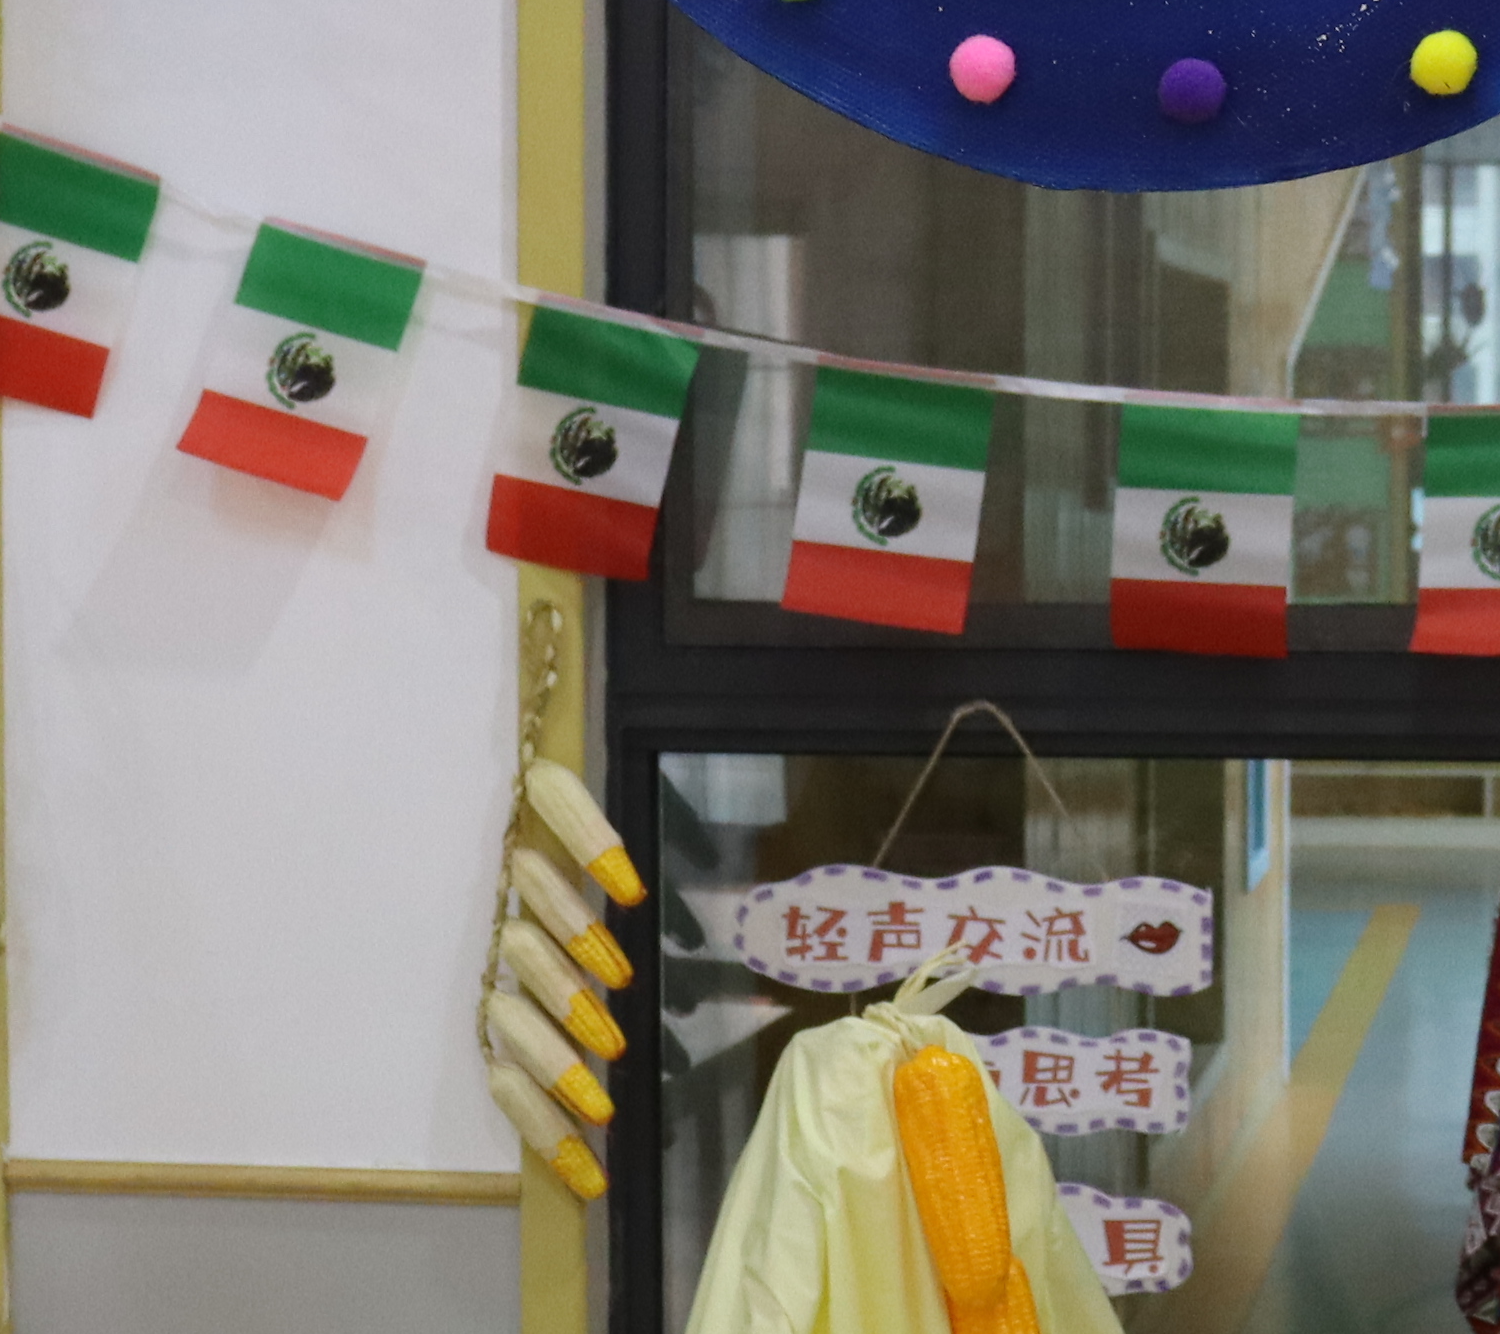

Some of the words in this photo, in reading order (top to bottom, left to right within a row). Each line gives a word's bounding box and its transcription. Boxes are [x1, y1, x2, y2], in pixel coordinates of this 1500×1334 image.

[782, 901, 1090, 964] 轻声交流
[984, 1049, 1160, 1108] 思考
